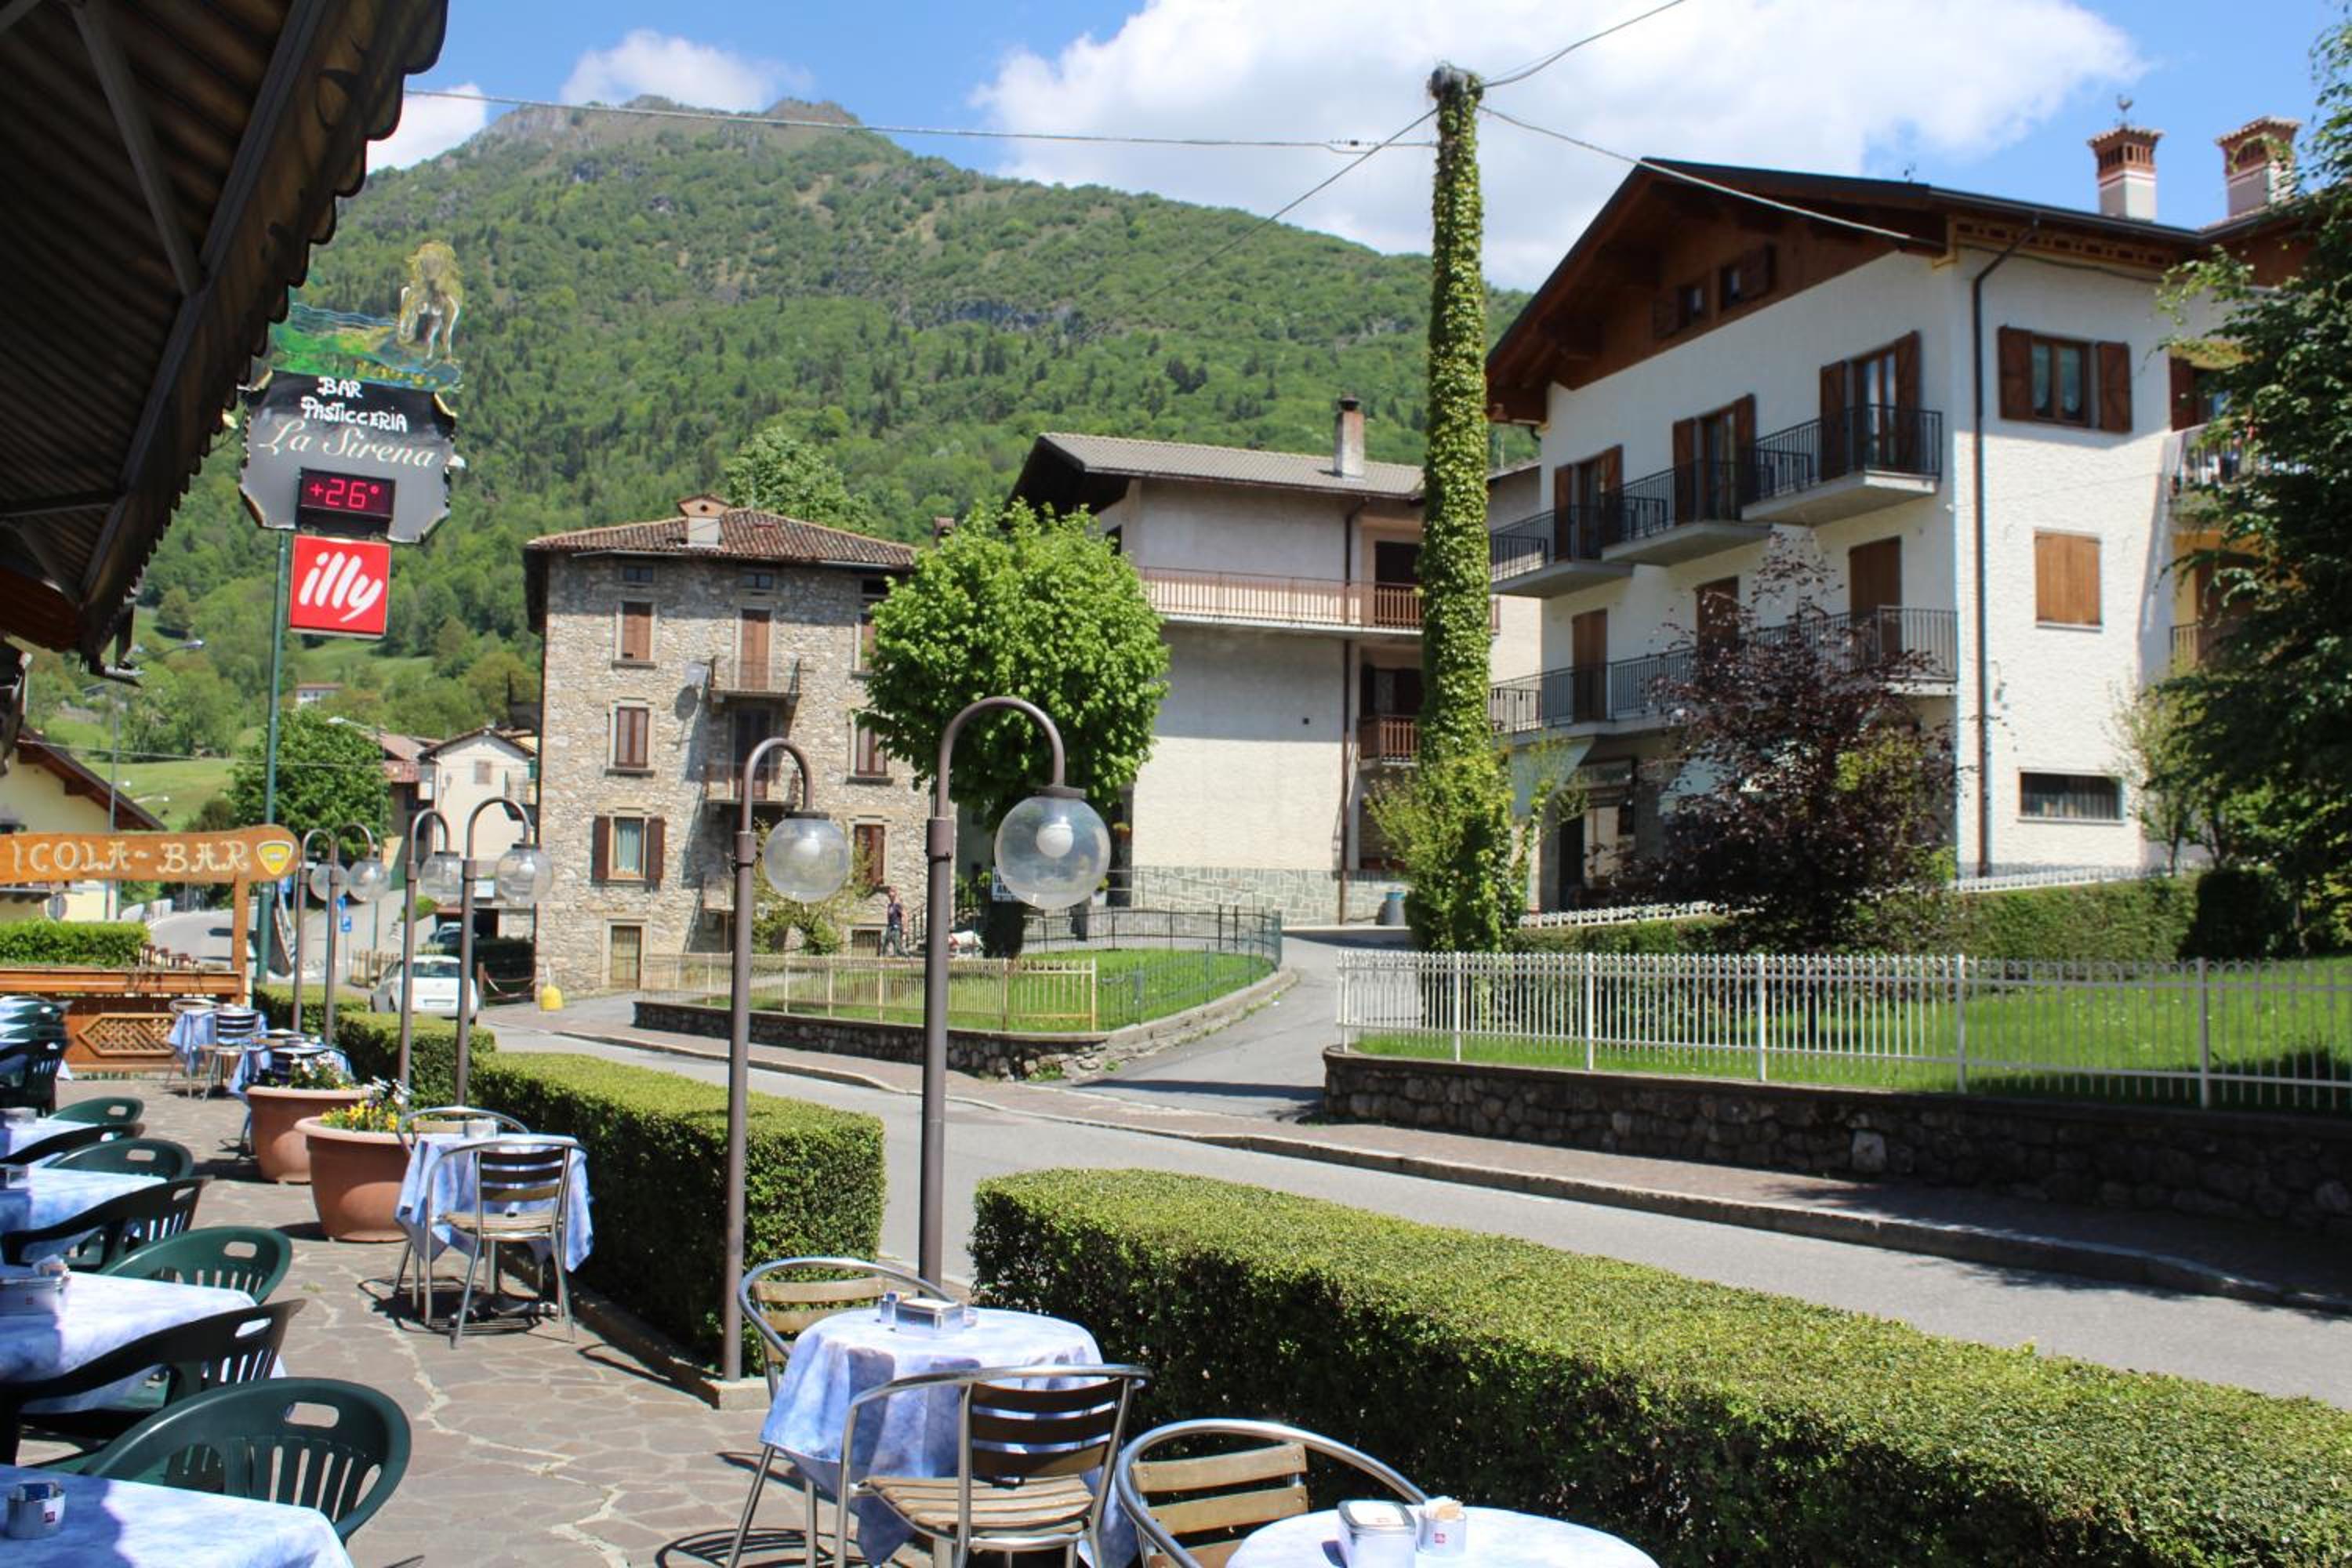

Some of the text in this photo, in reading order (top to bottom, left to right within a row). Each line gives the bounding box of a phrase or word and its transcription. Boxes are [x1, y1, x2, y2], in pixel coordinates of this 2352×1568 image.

[316, 376, 363, 398] BAR
[257, 419, 437, 467] La Sirena
[299, 551, 383, 623] illy
